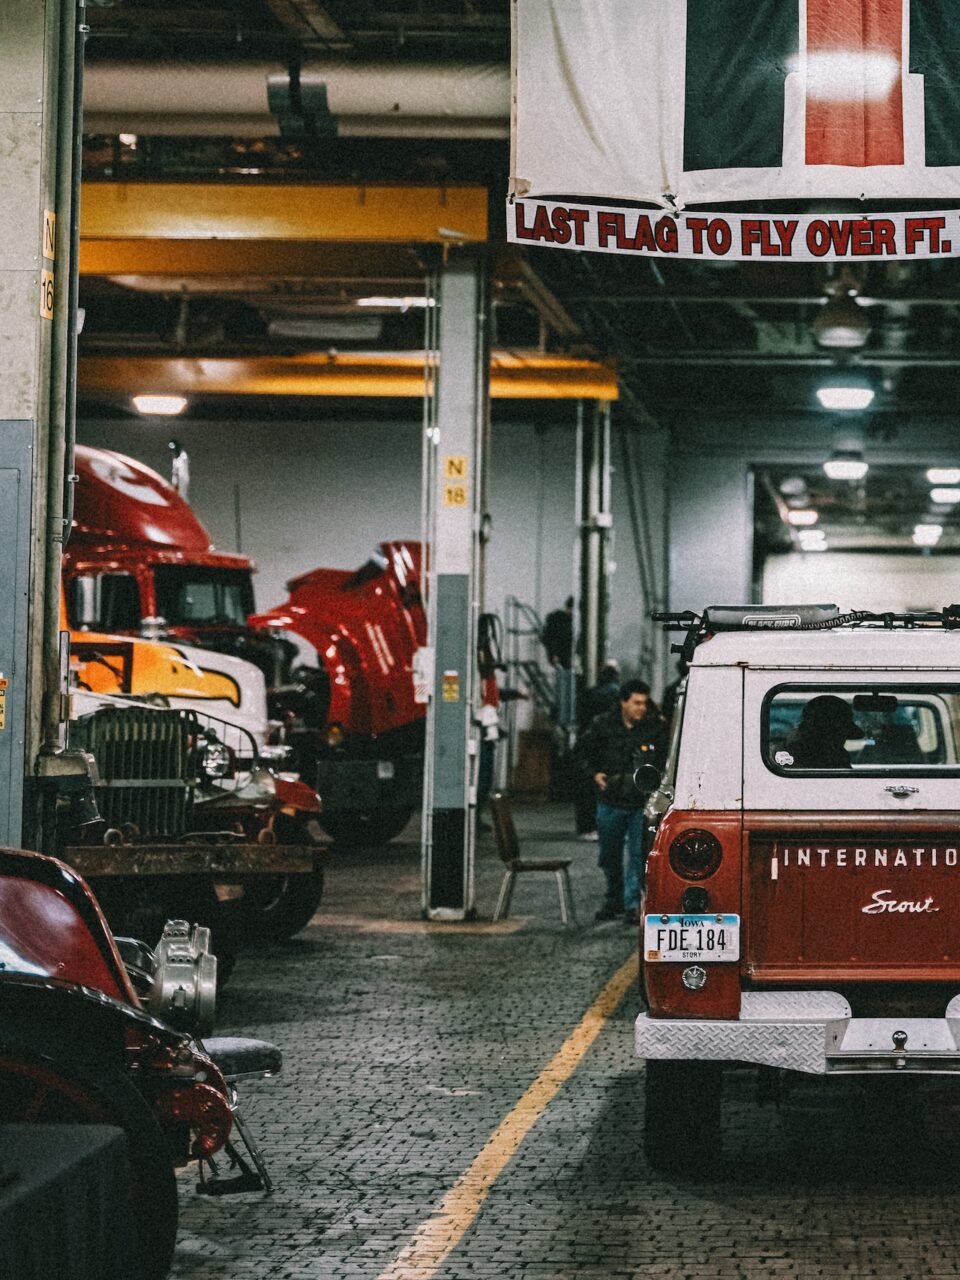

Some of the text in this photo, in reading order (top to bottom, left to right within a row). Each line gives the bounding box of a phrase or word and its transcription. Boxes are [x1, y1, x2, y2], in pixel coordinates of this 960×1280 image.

[45, 217, 55, 252] N
[515, 202, 590, 245] LAST
[597, 211, 679, 253] FLAG
[686, 217, 732, 256] TO
[741, 219, 799, 256] FLY
[806, 218, 897, 257] OVER
[905, 216, 952, 254] FT.
[42, 277, 54, 312] 16
[448, 460, 463, 475] N
[861, 889, 940, 915] Scout
[657, 929, 727, 951] FDE 184
